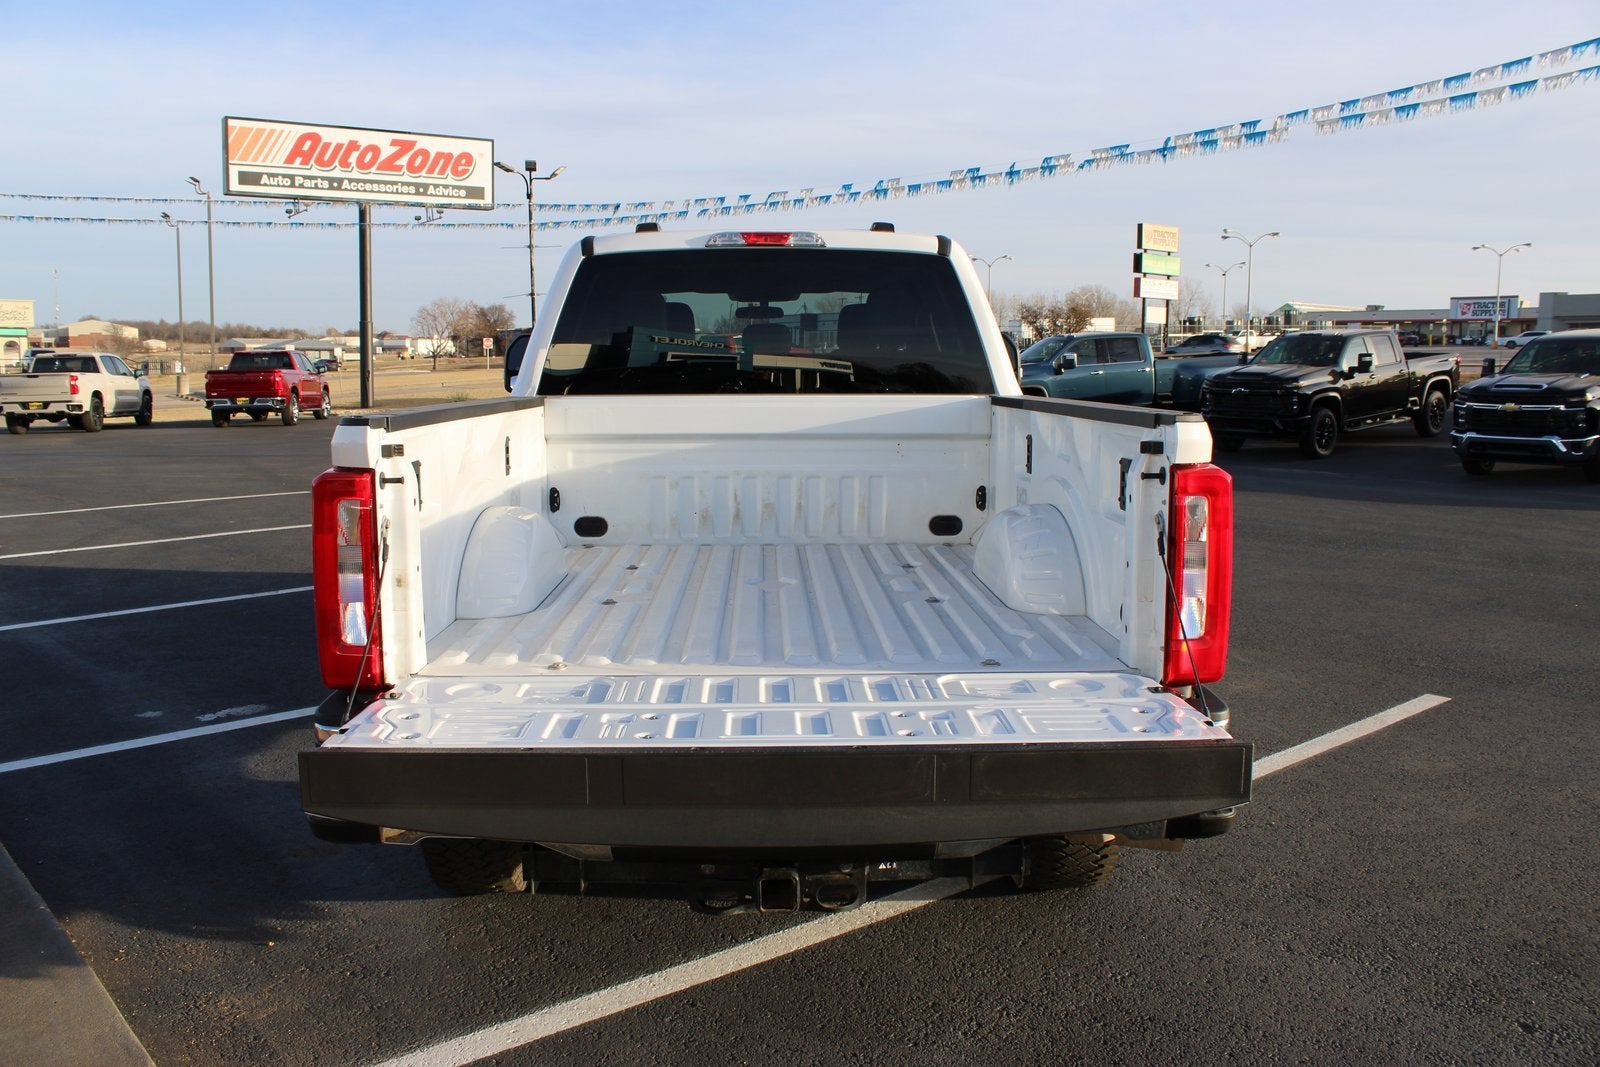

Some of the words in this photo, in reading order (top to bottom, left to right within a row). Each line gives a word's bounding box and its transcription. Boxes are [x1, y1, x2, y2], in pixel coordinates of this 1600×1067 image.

[283, 132, 474, 178] AutoZone
[260, 174, 291, 186] Auto
[294, 176, 330, 188] Parts
[341, 179, 416, 194] Accessories
[427, 185, 467, 197] Advice
